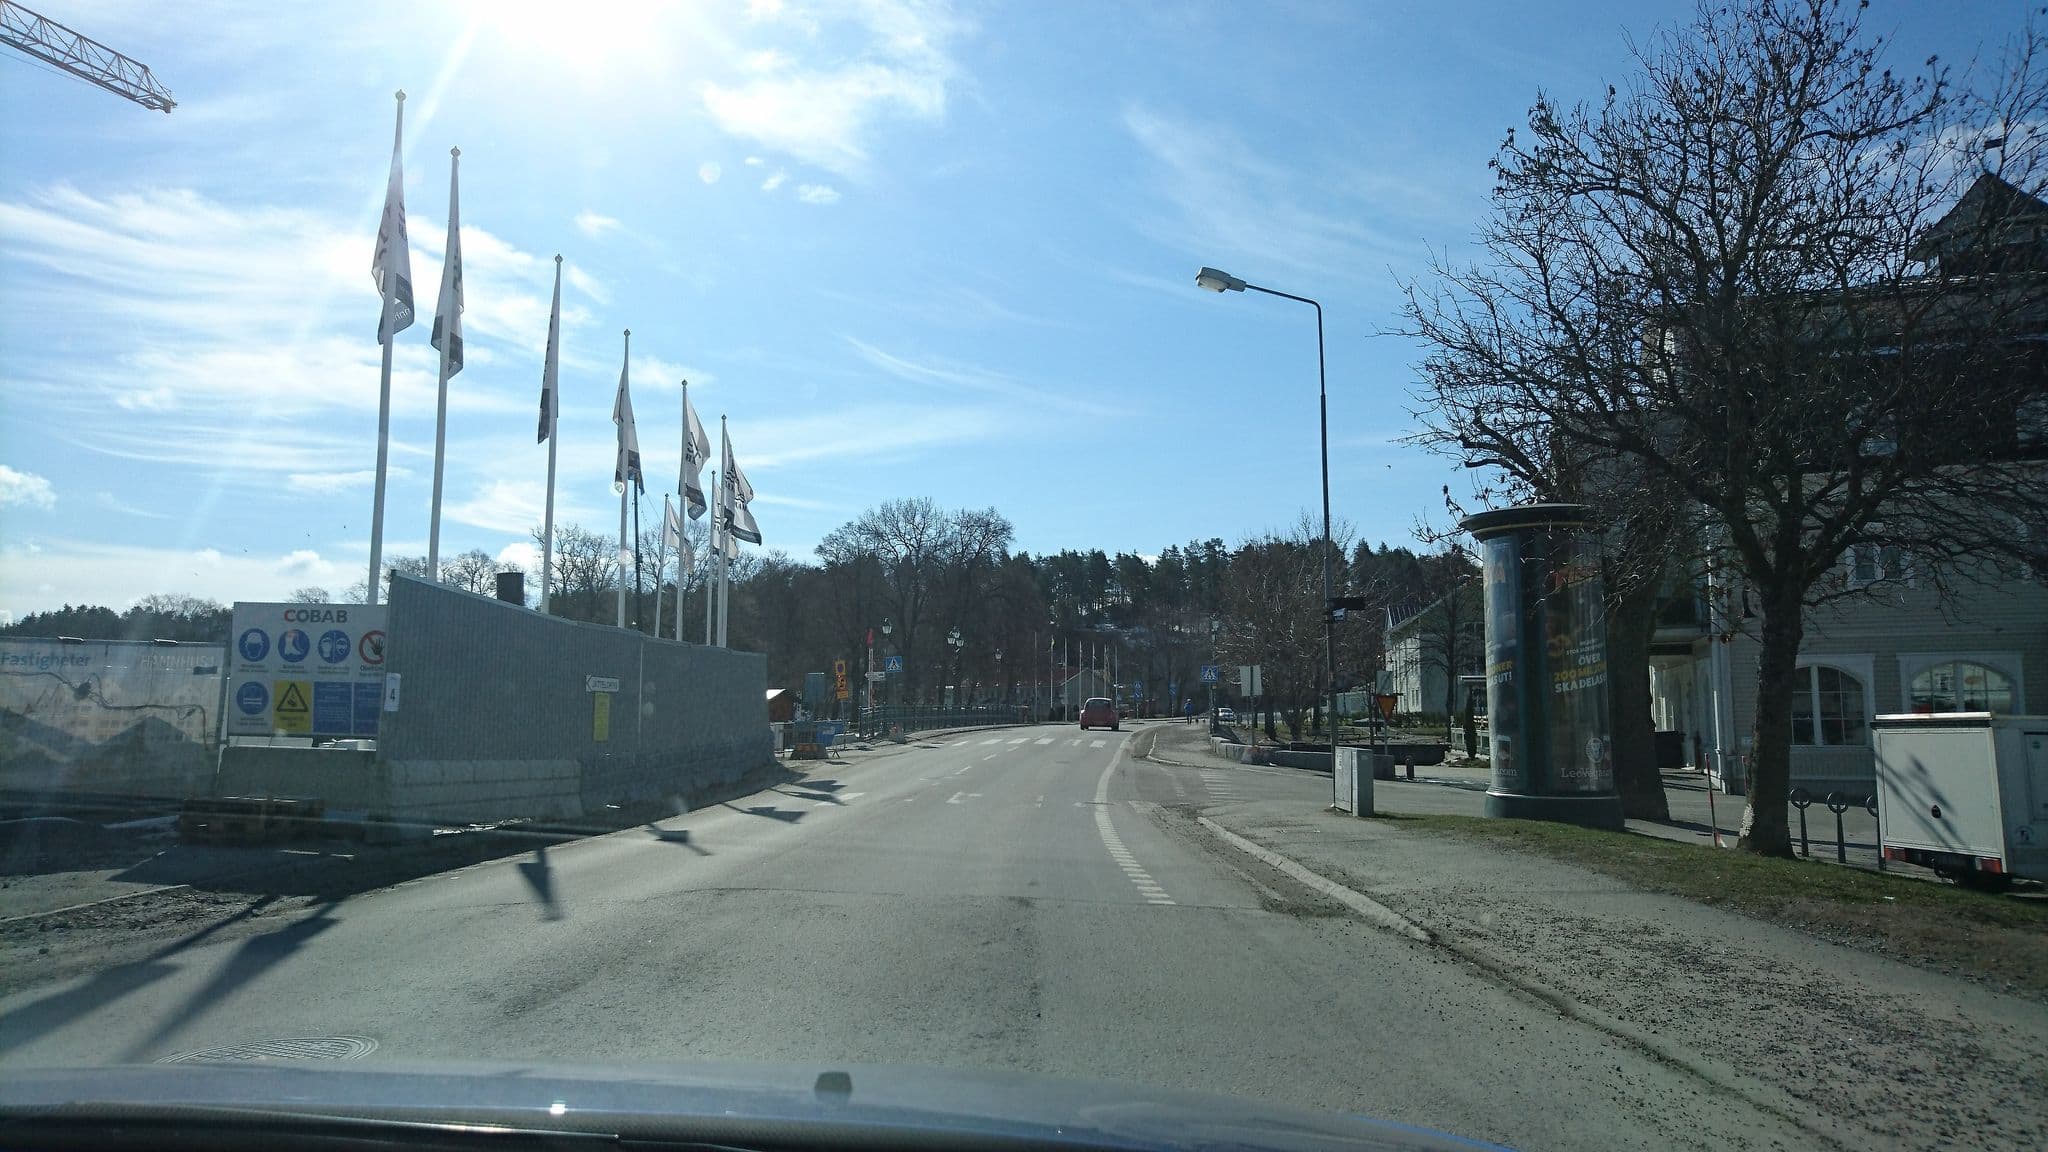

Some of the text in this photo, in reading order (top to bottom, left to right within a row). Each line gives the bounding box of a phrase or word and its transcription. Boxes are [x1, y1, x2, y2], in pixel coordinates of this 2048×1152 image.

[283, 608, 348, 623] COBAB
[1, 651, 90, 671] Fastigheter
[1578, 652, 1601, 666] ÖVER
[1554, 680, 1578, 693] SKA
[390, 688, 396, 703] 4
